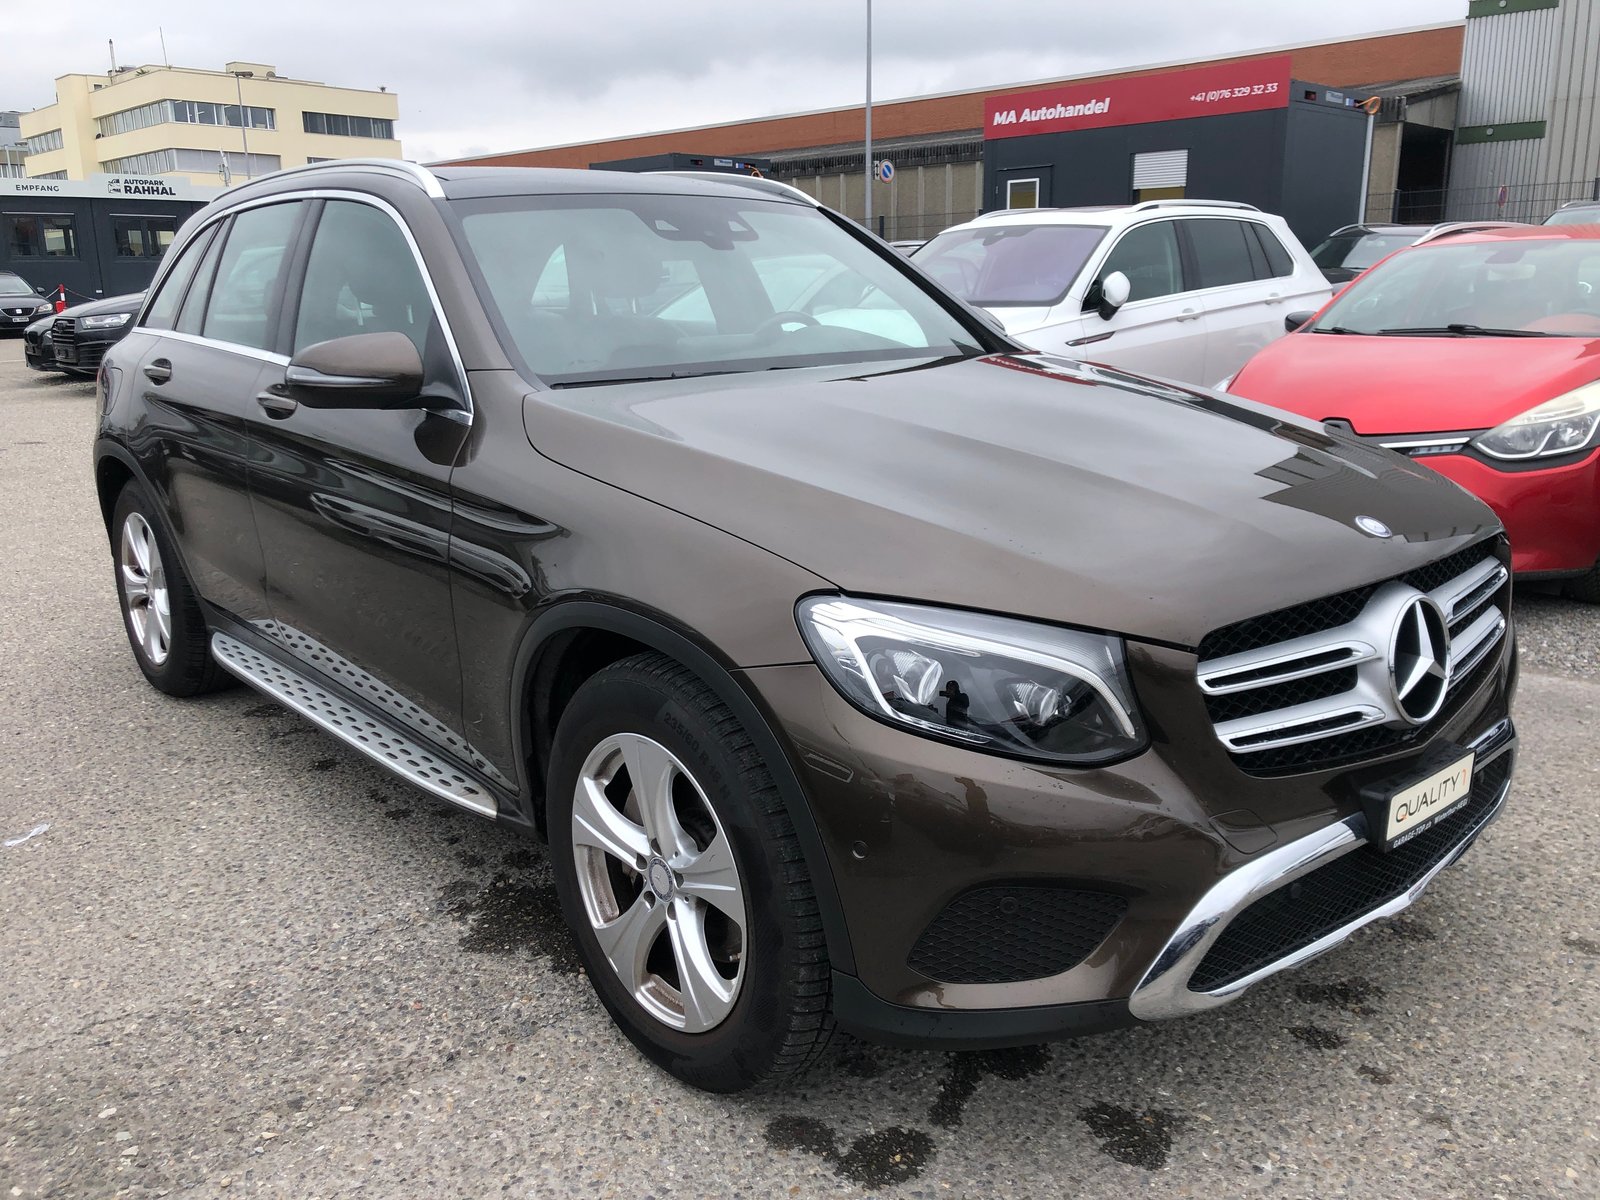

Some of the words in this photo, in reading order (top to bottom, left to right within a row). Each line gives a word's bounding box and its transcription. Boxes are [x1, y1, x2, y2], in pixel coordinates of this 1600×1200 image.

[1190, 92, 1206, 102] +41
[1231, 86, 1251, 98] 329
[1251, 84, 1265, 95] 32
[1265, 82, 1279, 93] 33
[992, 109, 1017, 126] MA
[1019, 97, 1111, 124] Autohandel
[15, 184, 60, 193] EMPFANG
[123, 178, 165, 187] AUTOPARK
[124, 185, 176, 196] RAHHAL
[664, 711, 700, 752] 235/60
